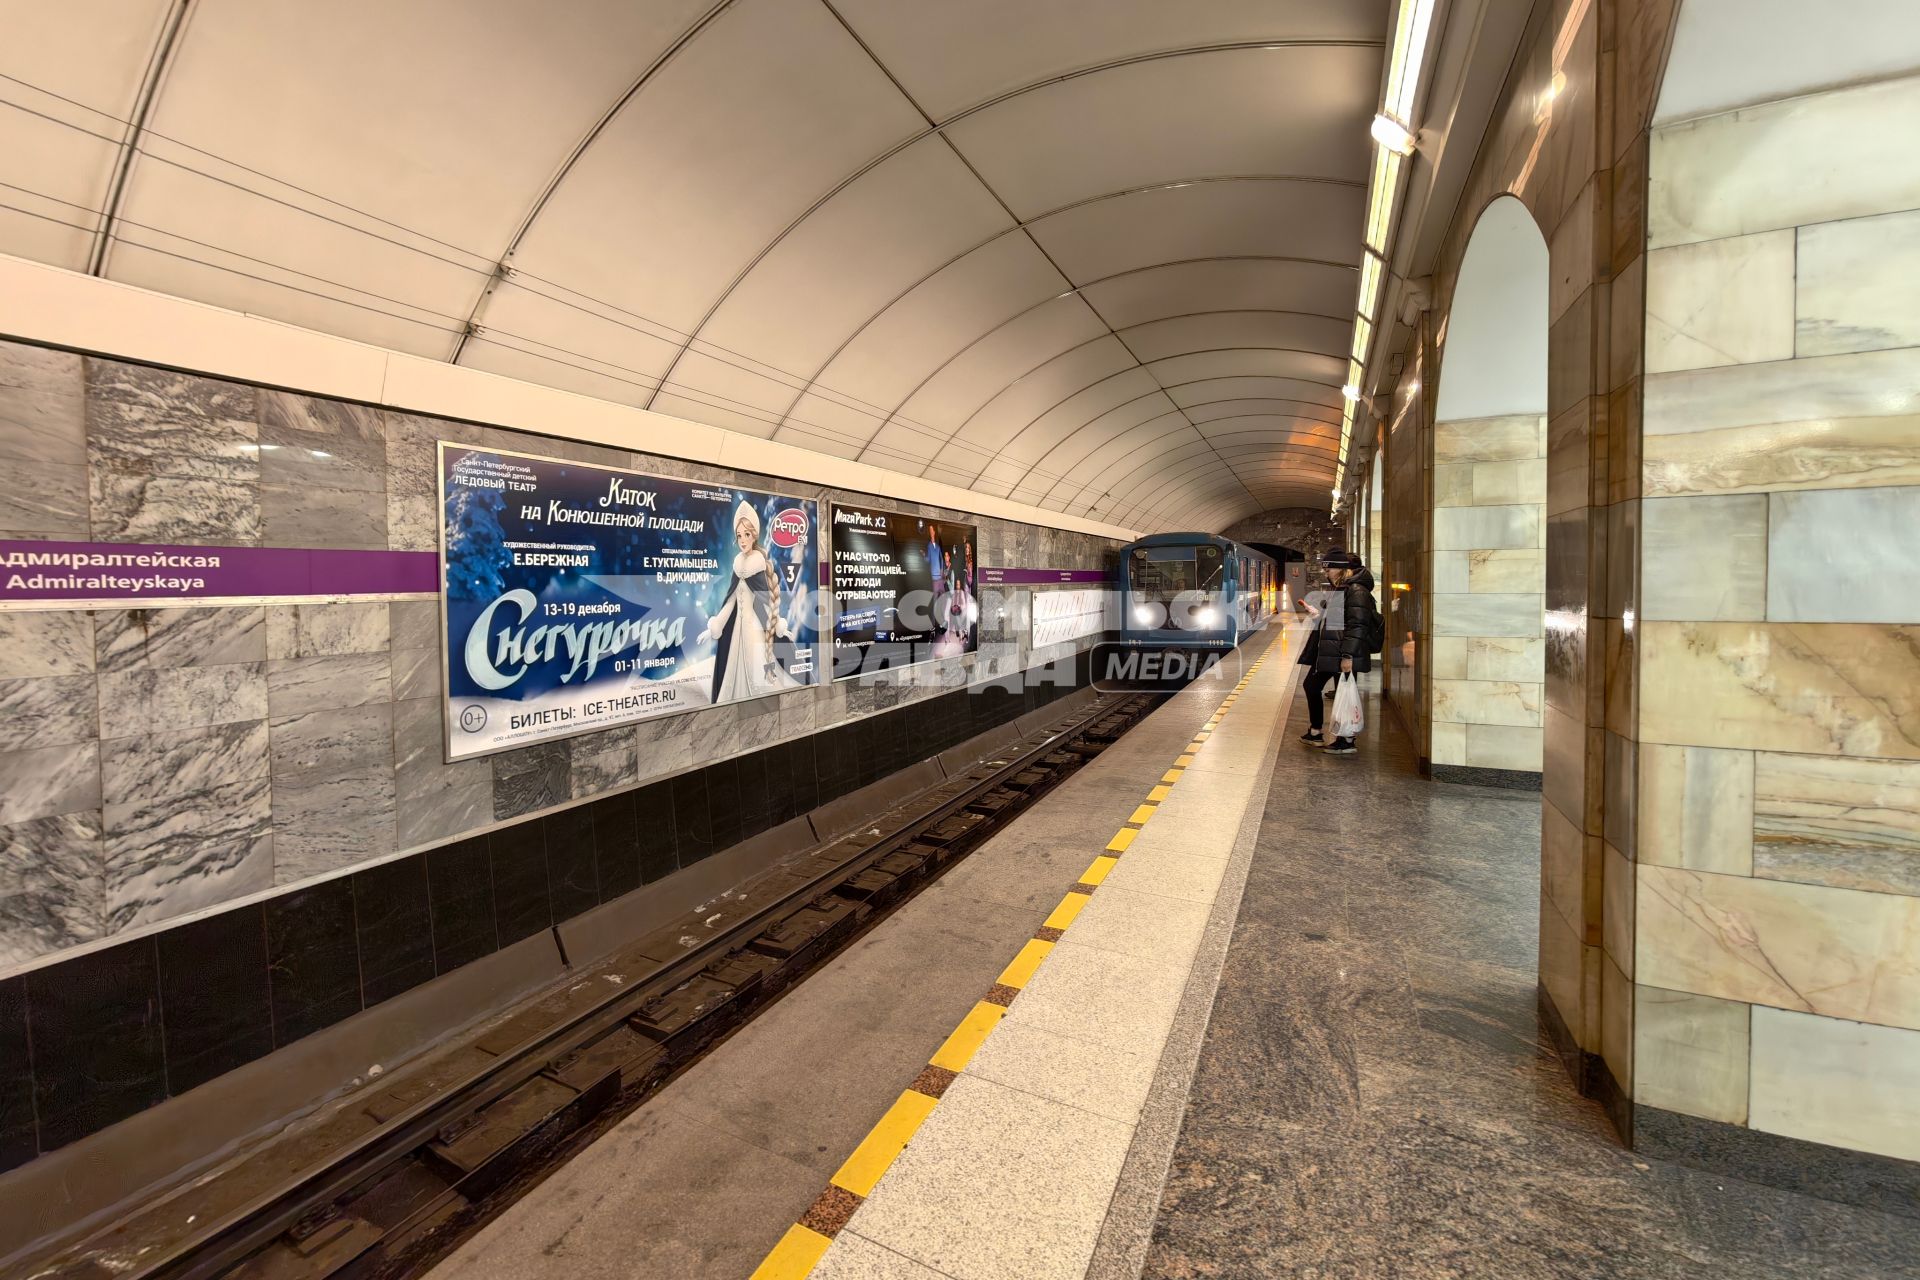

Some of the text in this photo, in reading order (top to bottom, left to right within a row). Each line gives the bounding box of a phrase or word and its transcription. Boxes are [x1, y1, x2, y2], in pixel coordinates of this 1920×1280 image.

[455, 475, 537, 493] ЛЕДОВЫЙ ТЕАТР
[503, 541, 596, 551] ХУДОЖЕСТВЕННЫЙ РУКОВОДИТЕЛЬ
[514, 553, 589, 567] Е.БЕРЕЖНАЯ
[835, 551, 890, 562] У НАС ЧТО-ТО
[787, 565, 795, 583] 3
[835, 564, 842, 574] С
[6, 574, 205, 592] Admiralteyskaya
[656, 572, 710, 584] В.ДИКИДЖИ
[835, 577, 881, 588] ТУТ ЛЮДИ
[835, 589, 896, 601] ОТРЫВАЮТСЯ!
[543, 602, 621, 617] 13-19 декабря
[464, 588, 687, 691] Снегурочка
[614, 657, 675, 672] 01-11 января
[510, 706, 576, 730] БИЛЕТЫ:
[583, 689, 676, 716] ICE-THEATER.RU
[464, 712, 484, 726] 0+
